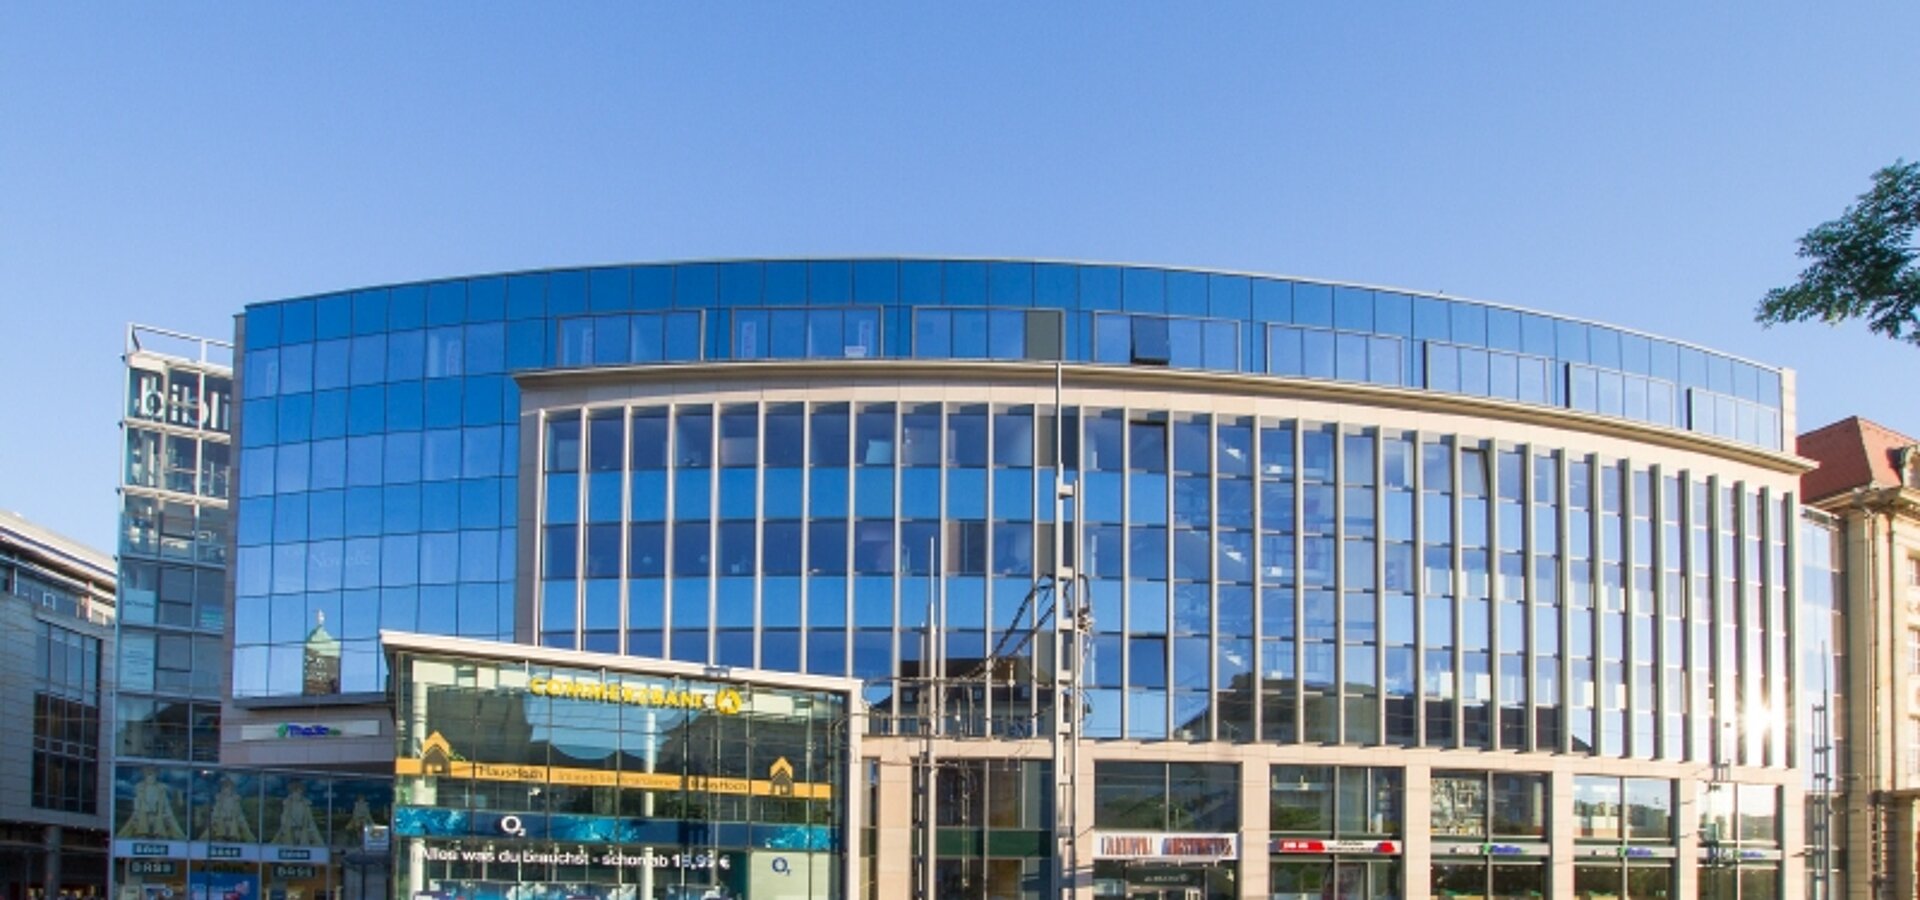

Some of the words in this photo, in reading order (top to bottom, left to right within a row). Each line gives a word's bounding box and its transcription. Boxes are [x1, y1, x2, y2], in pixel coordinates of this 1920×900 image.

[529, 677, 706, 709] COMMERZBANK
[461, 851, 496, 864] was
[499, 851, 521, 864] du
[523, 851, 590, 866] brauchst
